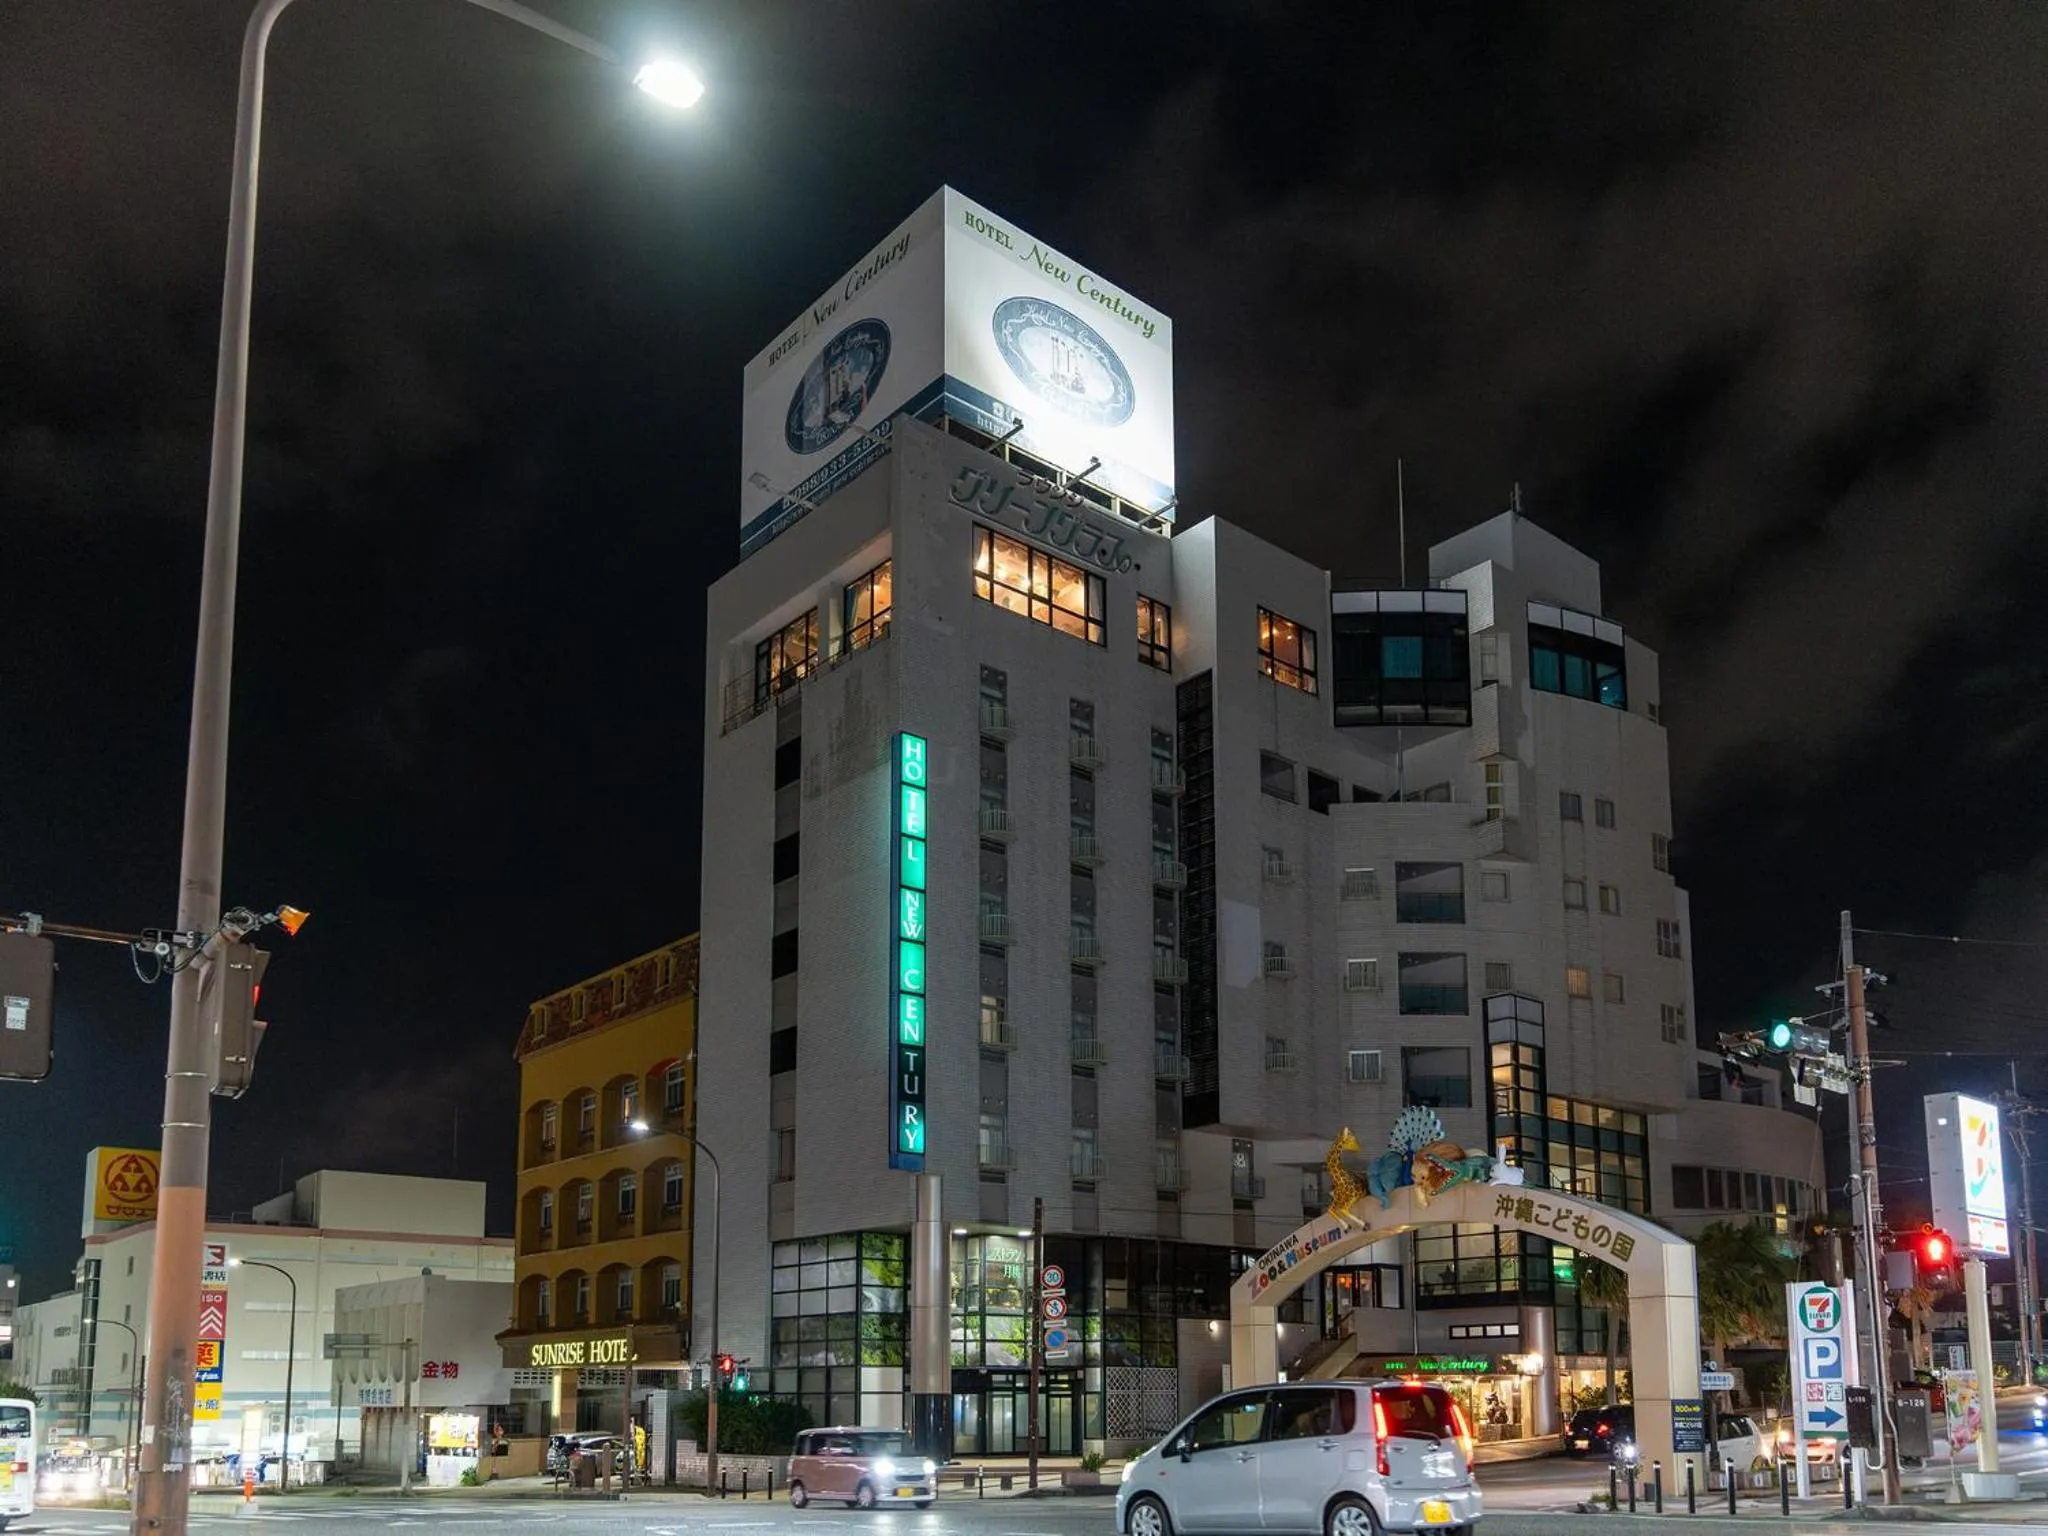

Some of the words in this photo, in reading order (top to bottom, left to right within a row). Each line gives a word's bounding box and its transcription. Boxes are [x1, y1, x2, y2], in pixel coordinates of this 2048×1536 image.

[965, 211, 1013, 250] HOTEL
[1020, 244, 1070, 283] New
[1077, 275, 1156, 338] Century
[769, 330, 799, 367] HOTEL
[844, 233, 910, 301] Century
[904, 739, 922, 861] HOTEL
[903, 893, 922, 938] NEW
[903, 969, 921, 1149] CENTURY
[1494, 1193, 1636, 1263] 沖縄こどもの国
[1258, 1234, 1300, 1270] OKINAWA
[1047, 1271, 1059, 1282] 30
[201, 1295, 223, 1303] ISO
[421, 1360, 460, 1379] 金物
[531, 1342, 584, 1366] SUNRISE
[589, 1338, 637, 1363] HOTE
[1808, 1340, 1838, 1378] P
